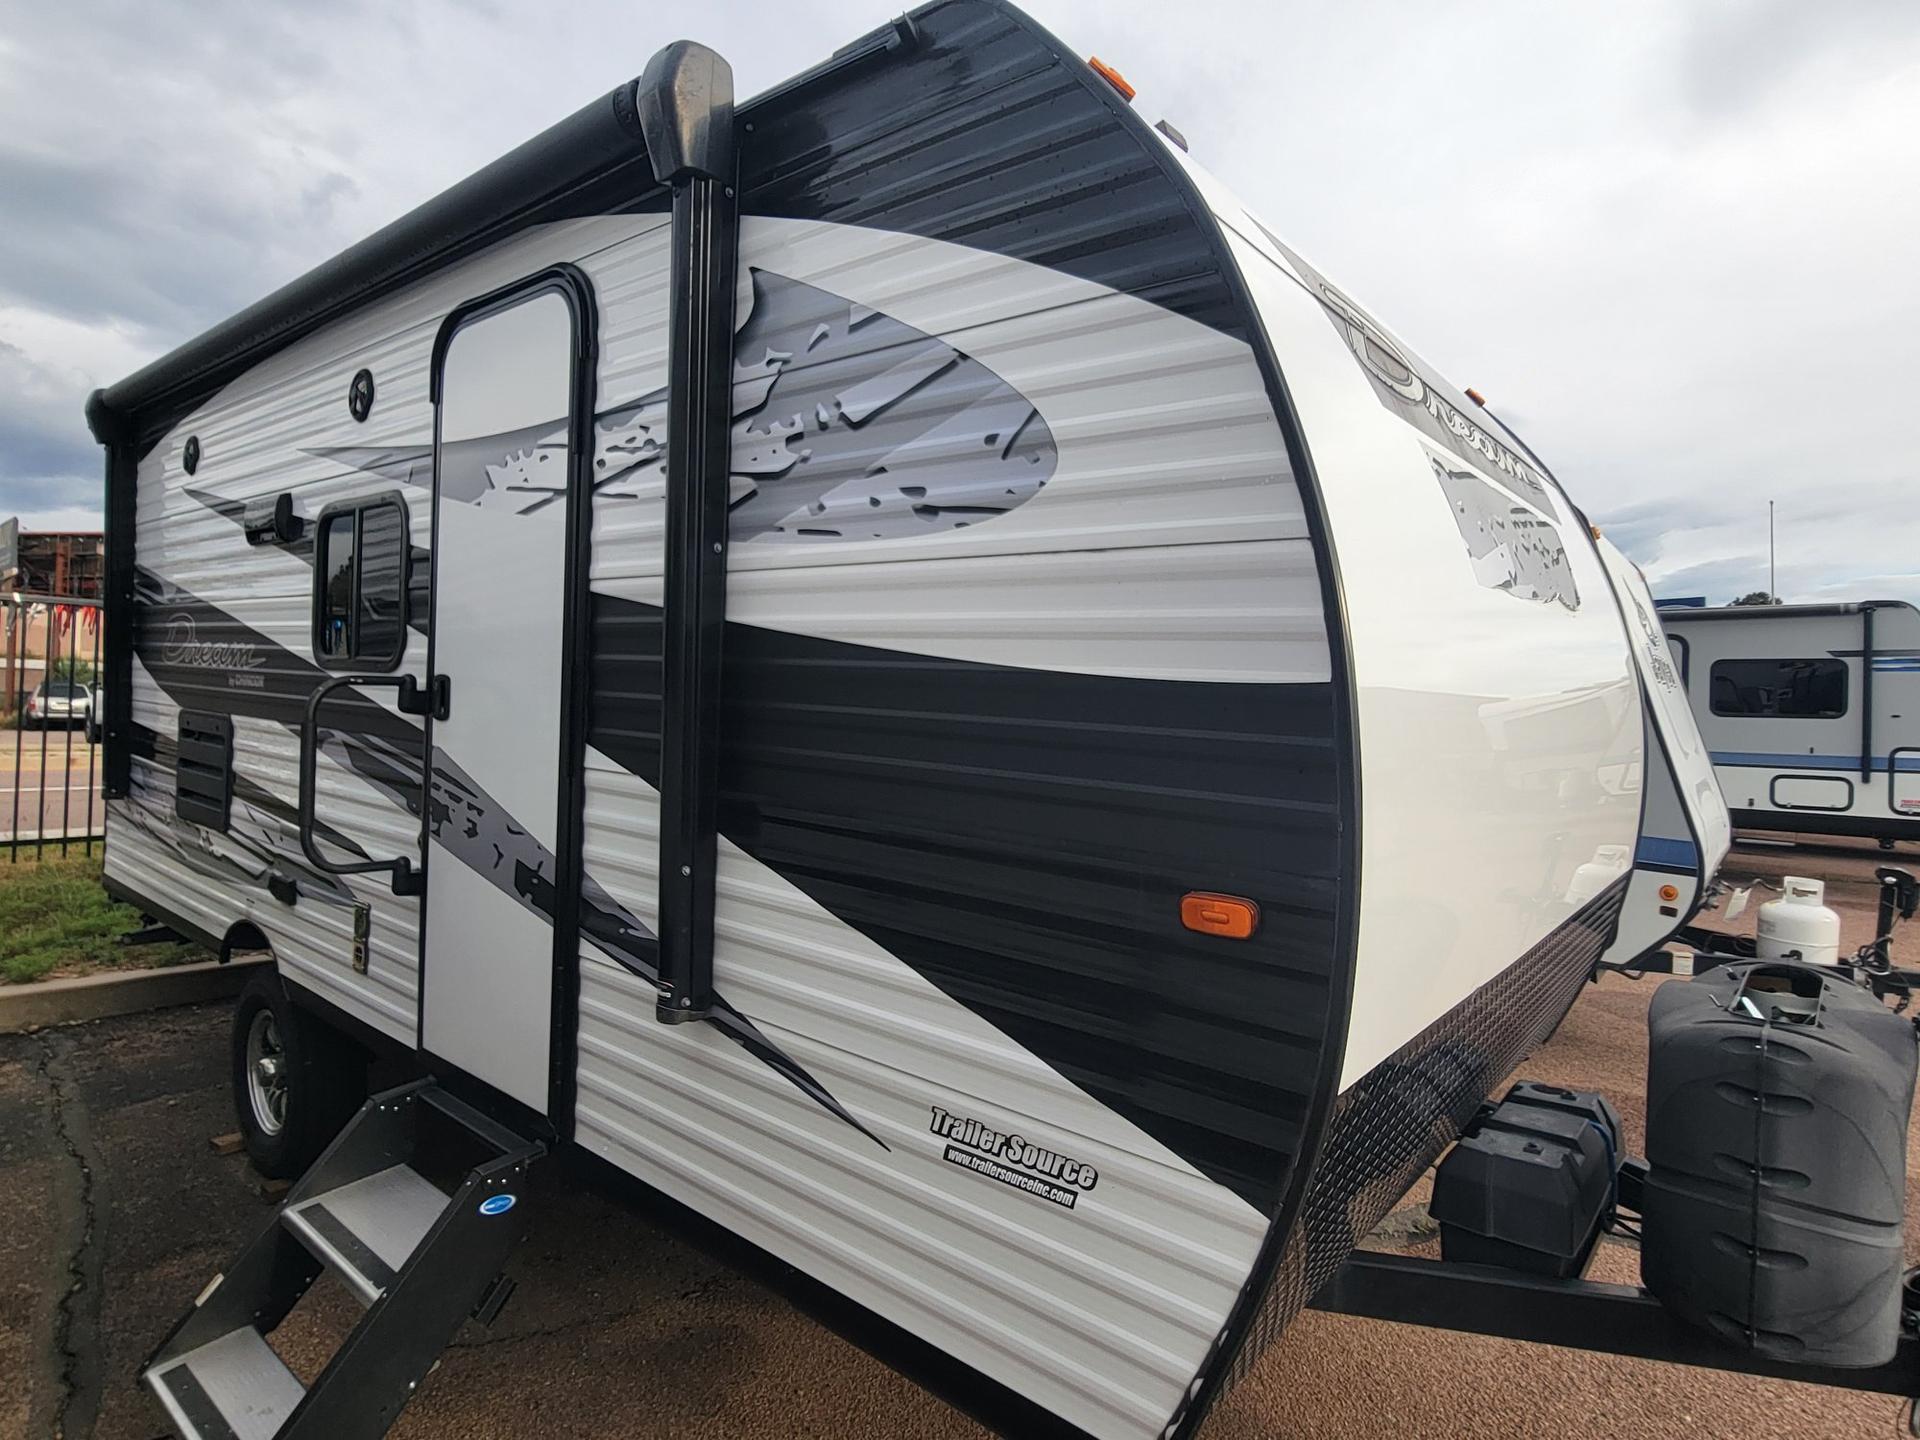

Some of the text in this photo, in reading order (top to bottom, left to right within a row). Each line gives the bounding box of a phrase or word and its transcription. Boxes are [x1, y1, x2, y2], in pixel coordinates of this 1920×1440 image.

[161, 612, 267, 669] Dream
[929, 1106, 1099, 1191] Trailer Source
[946, 1148, 1076, 1208] www.trailersourceinc.com
